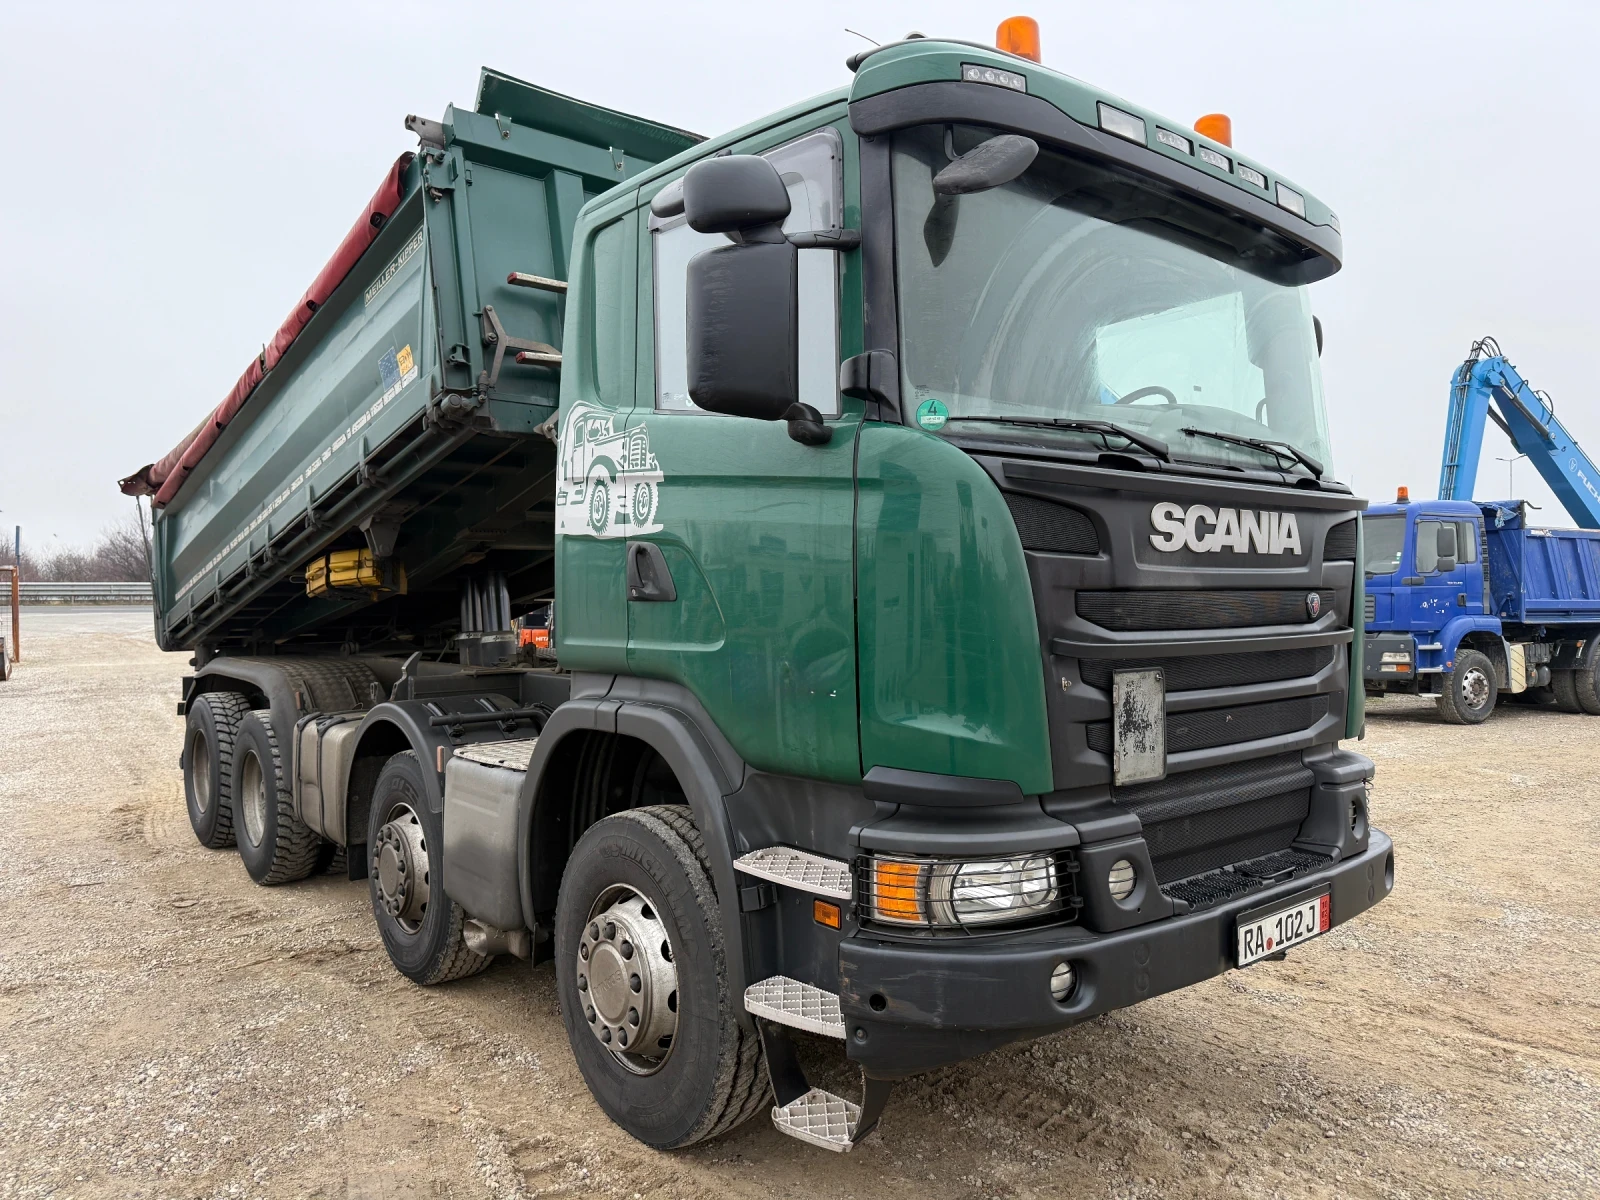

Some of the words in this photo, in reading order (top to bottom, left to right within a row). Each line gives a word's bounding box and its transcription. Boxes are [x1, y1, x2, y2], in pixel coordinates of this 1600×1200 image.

[364, 231, 424, 304] MEILLER-KIPPER
[928, 401, 937, 416] 4
[1149, 502, 1303, 555] SCANIA
[1244, 924, 1265, 960] RA
